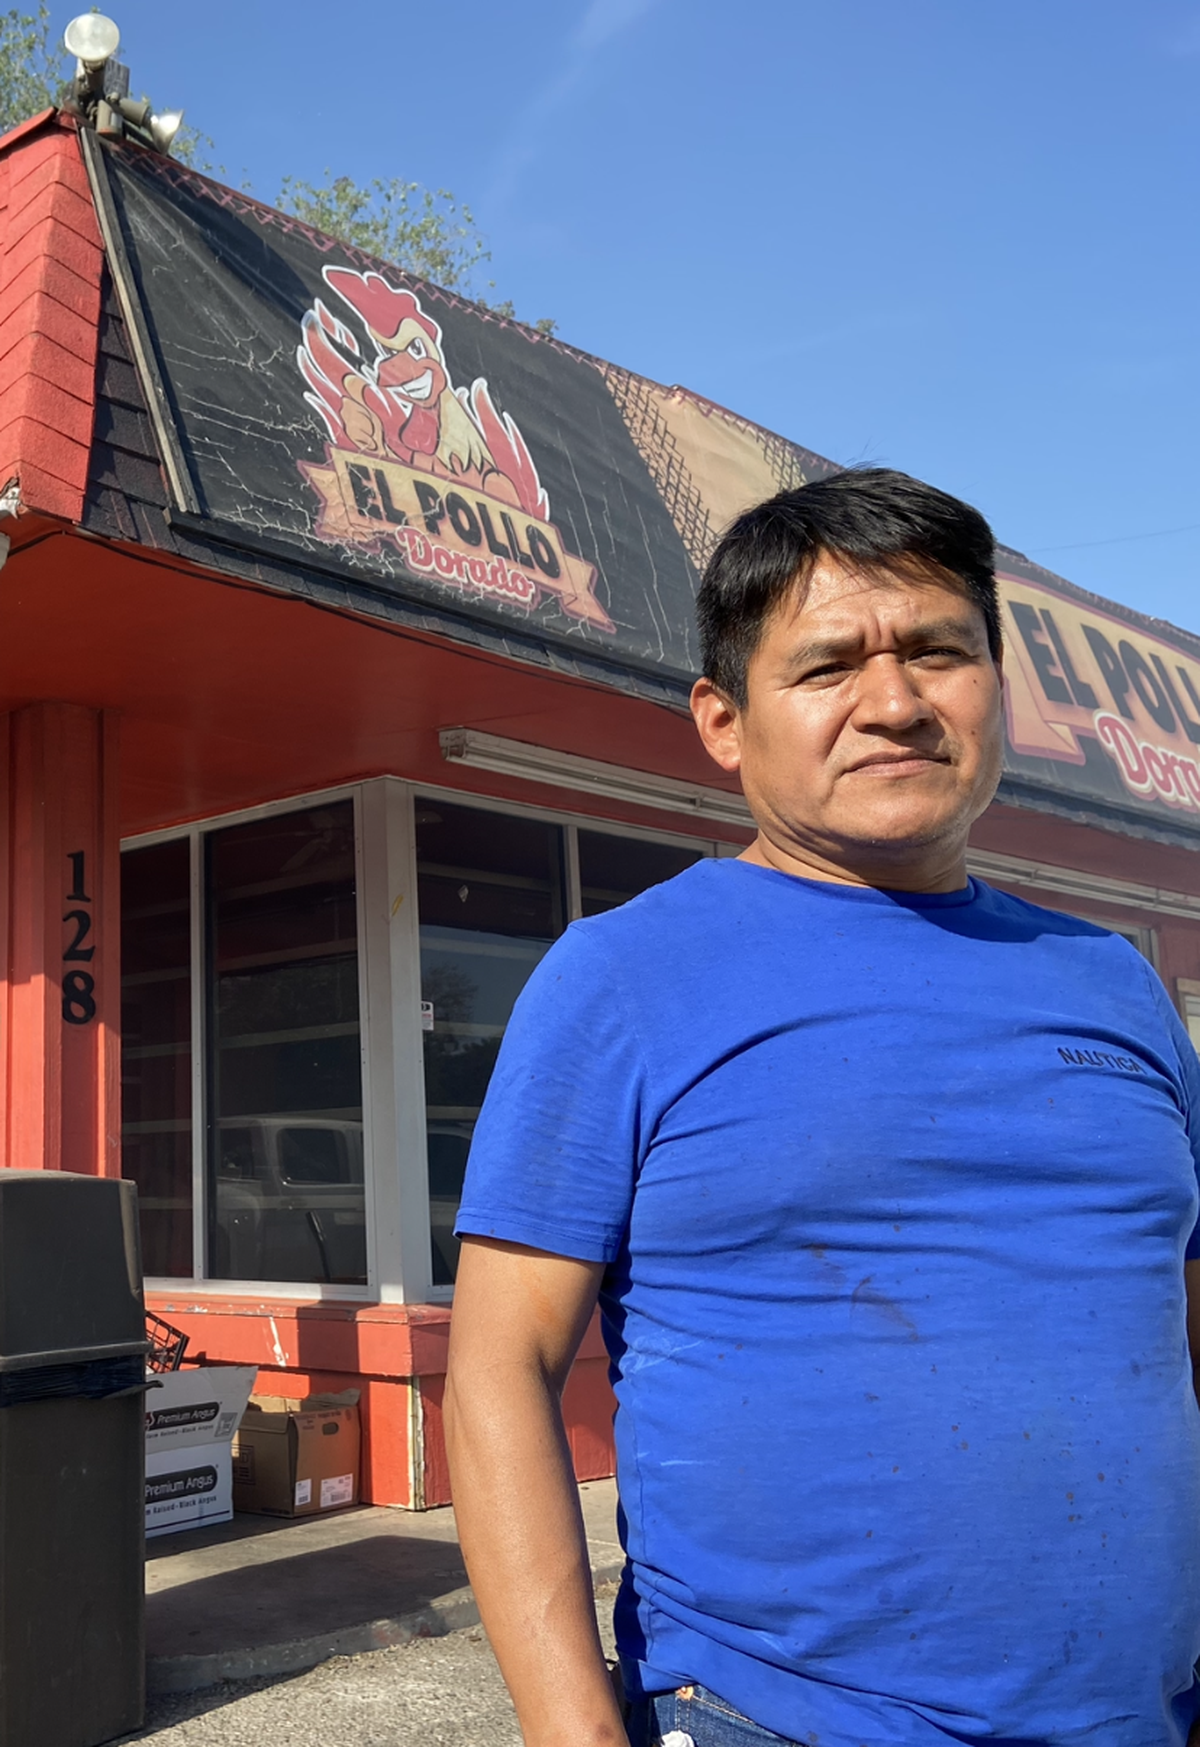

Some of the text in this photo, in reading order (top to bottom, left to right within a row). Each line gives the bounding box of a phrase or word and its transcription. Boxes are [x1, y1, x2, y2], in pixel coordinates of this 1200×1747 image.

[348, 462, 562, 579] EL POLLO
[396, 525, 535, 602] Dorado
[1008, 600, 1100, 710] EL
[62, 850, 96, 1025] 128
[1057, 1047, 1147, 1076] NAUTICA
[157, 1412, 190, 1425] Premium
[191, 1408, 216, 1420] Angus
[145, 1474, 213, 1497] Premium Angus
[197, 1494, 217, 1505] Angus
